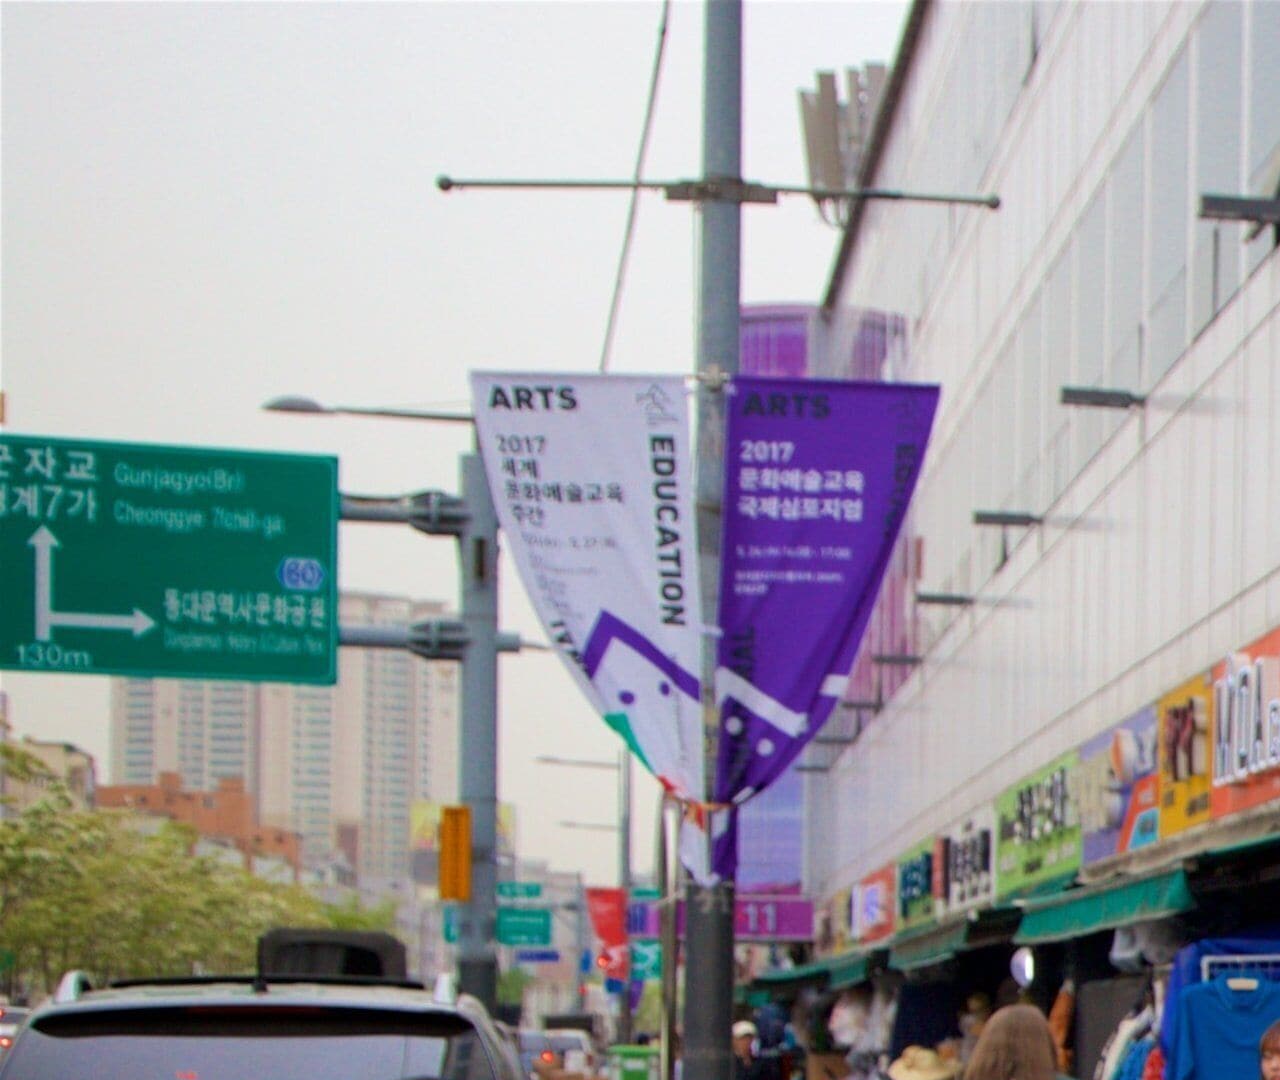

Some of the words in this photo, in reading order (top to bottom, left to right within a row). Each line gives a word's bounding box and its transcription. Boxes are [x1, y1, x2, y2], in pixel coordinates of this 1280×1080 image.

[489, 385, 578, 411] ARTS
[743, 392, 832, 419] ARTS
[496, 434, 547, 453] 2017
[740, 441, 794, 463] 2017
[739, 468, 864, 494] 문화예술교육
[0, 485, 96, 522] 계7가
[738, 496, 863, 521] 국제심포지엄
[650, 434, 686, 626] EDUCATION
[17, 645, 90, 666] 130m
[742, 905, 777, 930] 11
